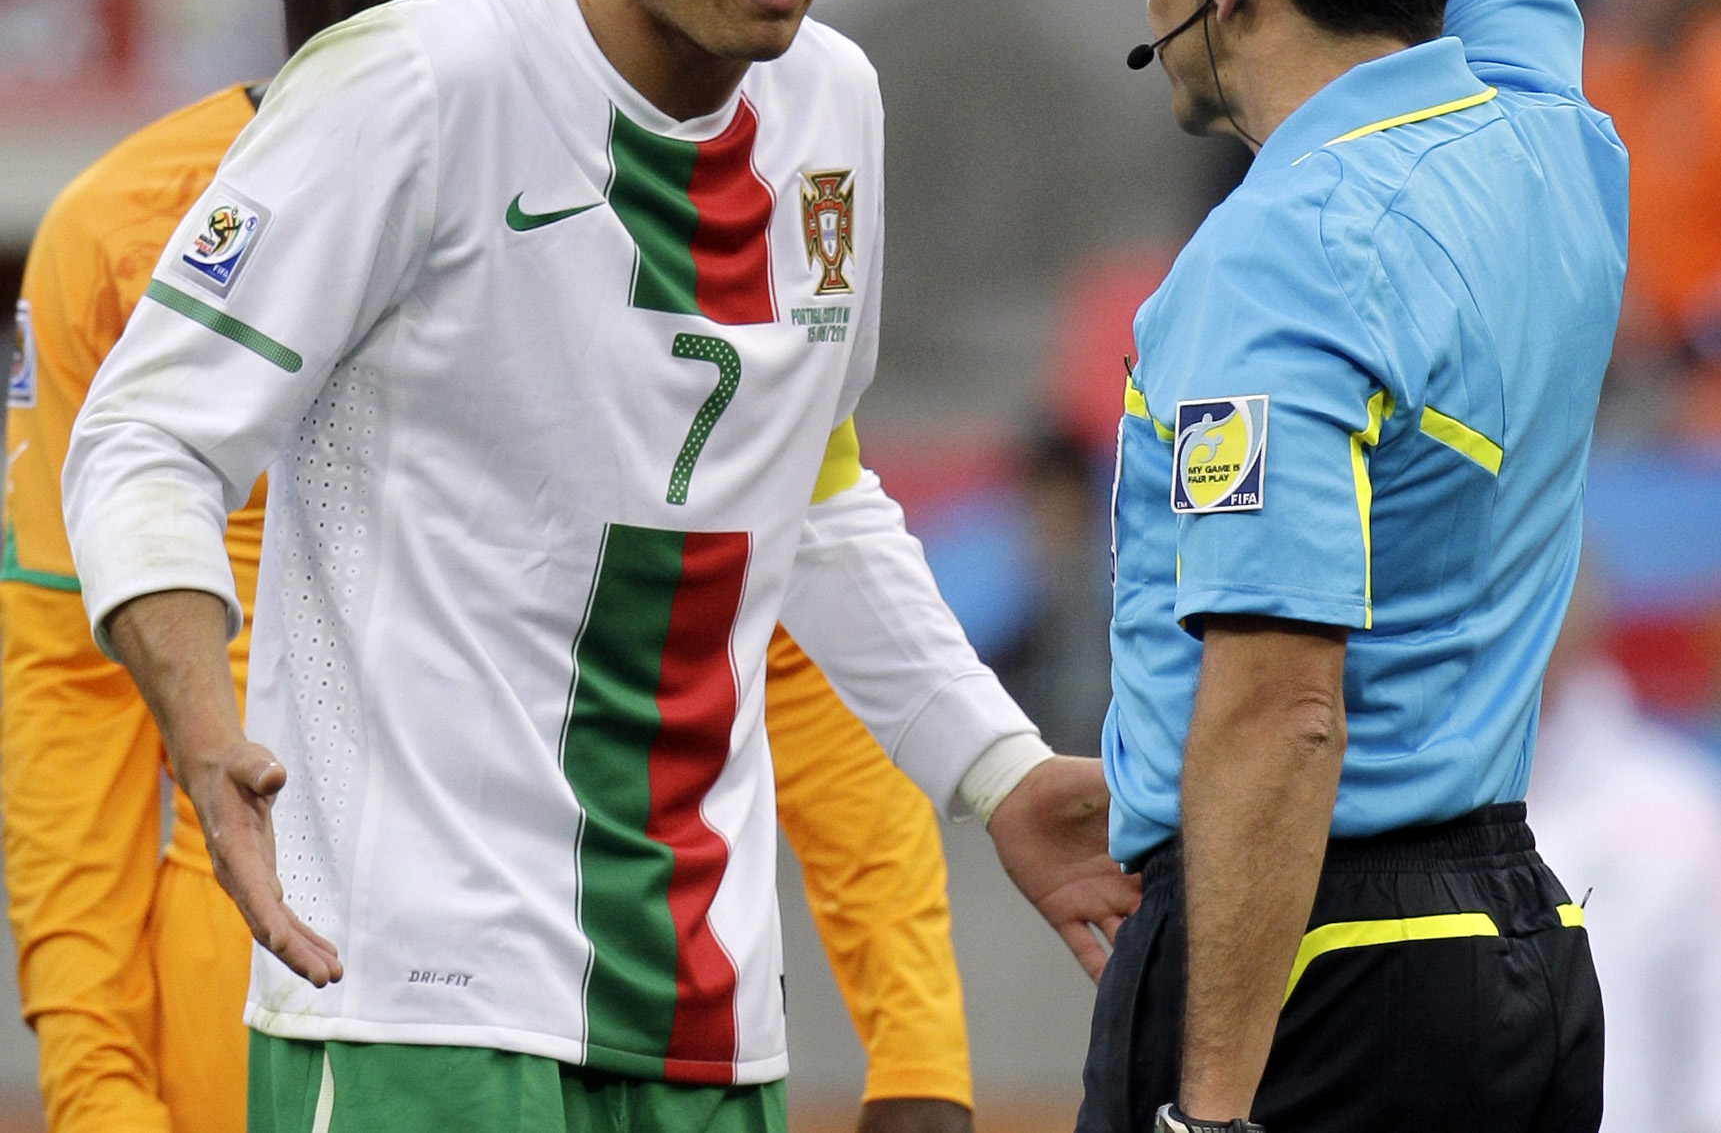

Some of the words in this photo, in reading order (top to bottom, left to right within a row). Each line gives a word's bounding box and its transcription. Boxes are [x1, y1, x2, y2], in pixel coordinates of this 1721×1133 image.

[213, 265, 229, 278] FIFA
[666, 332, 741, 505] 7
[1188, 466, 1202, 474] MY
[1205, 464, 1230, 473] GAME
[1188, 475, 1206, 483] FAIR
[1208, 474, 1229, 482] PLAY
[1231, 493, 1257, 505] FIFA
[408, 970, 474, 987] DRI-FIT
